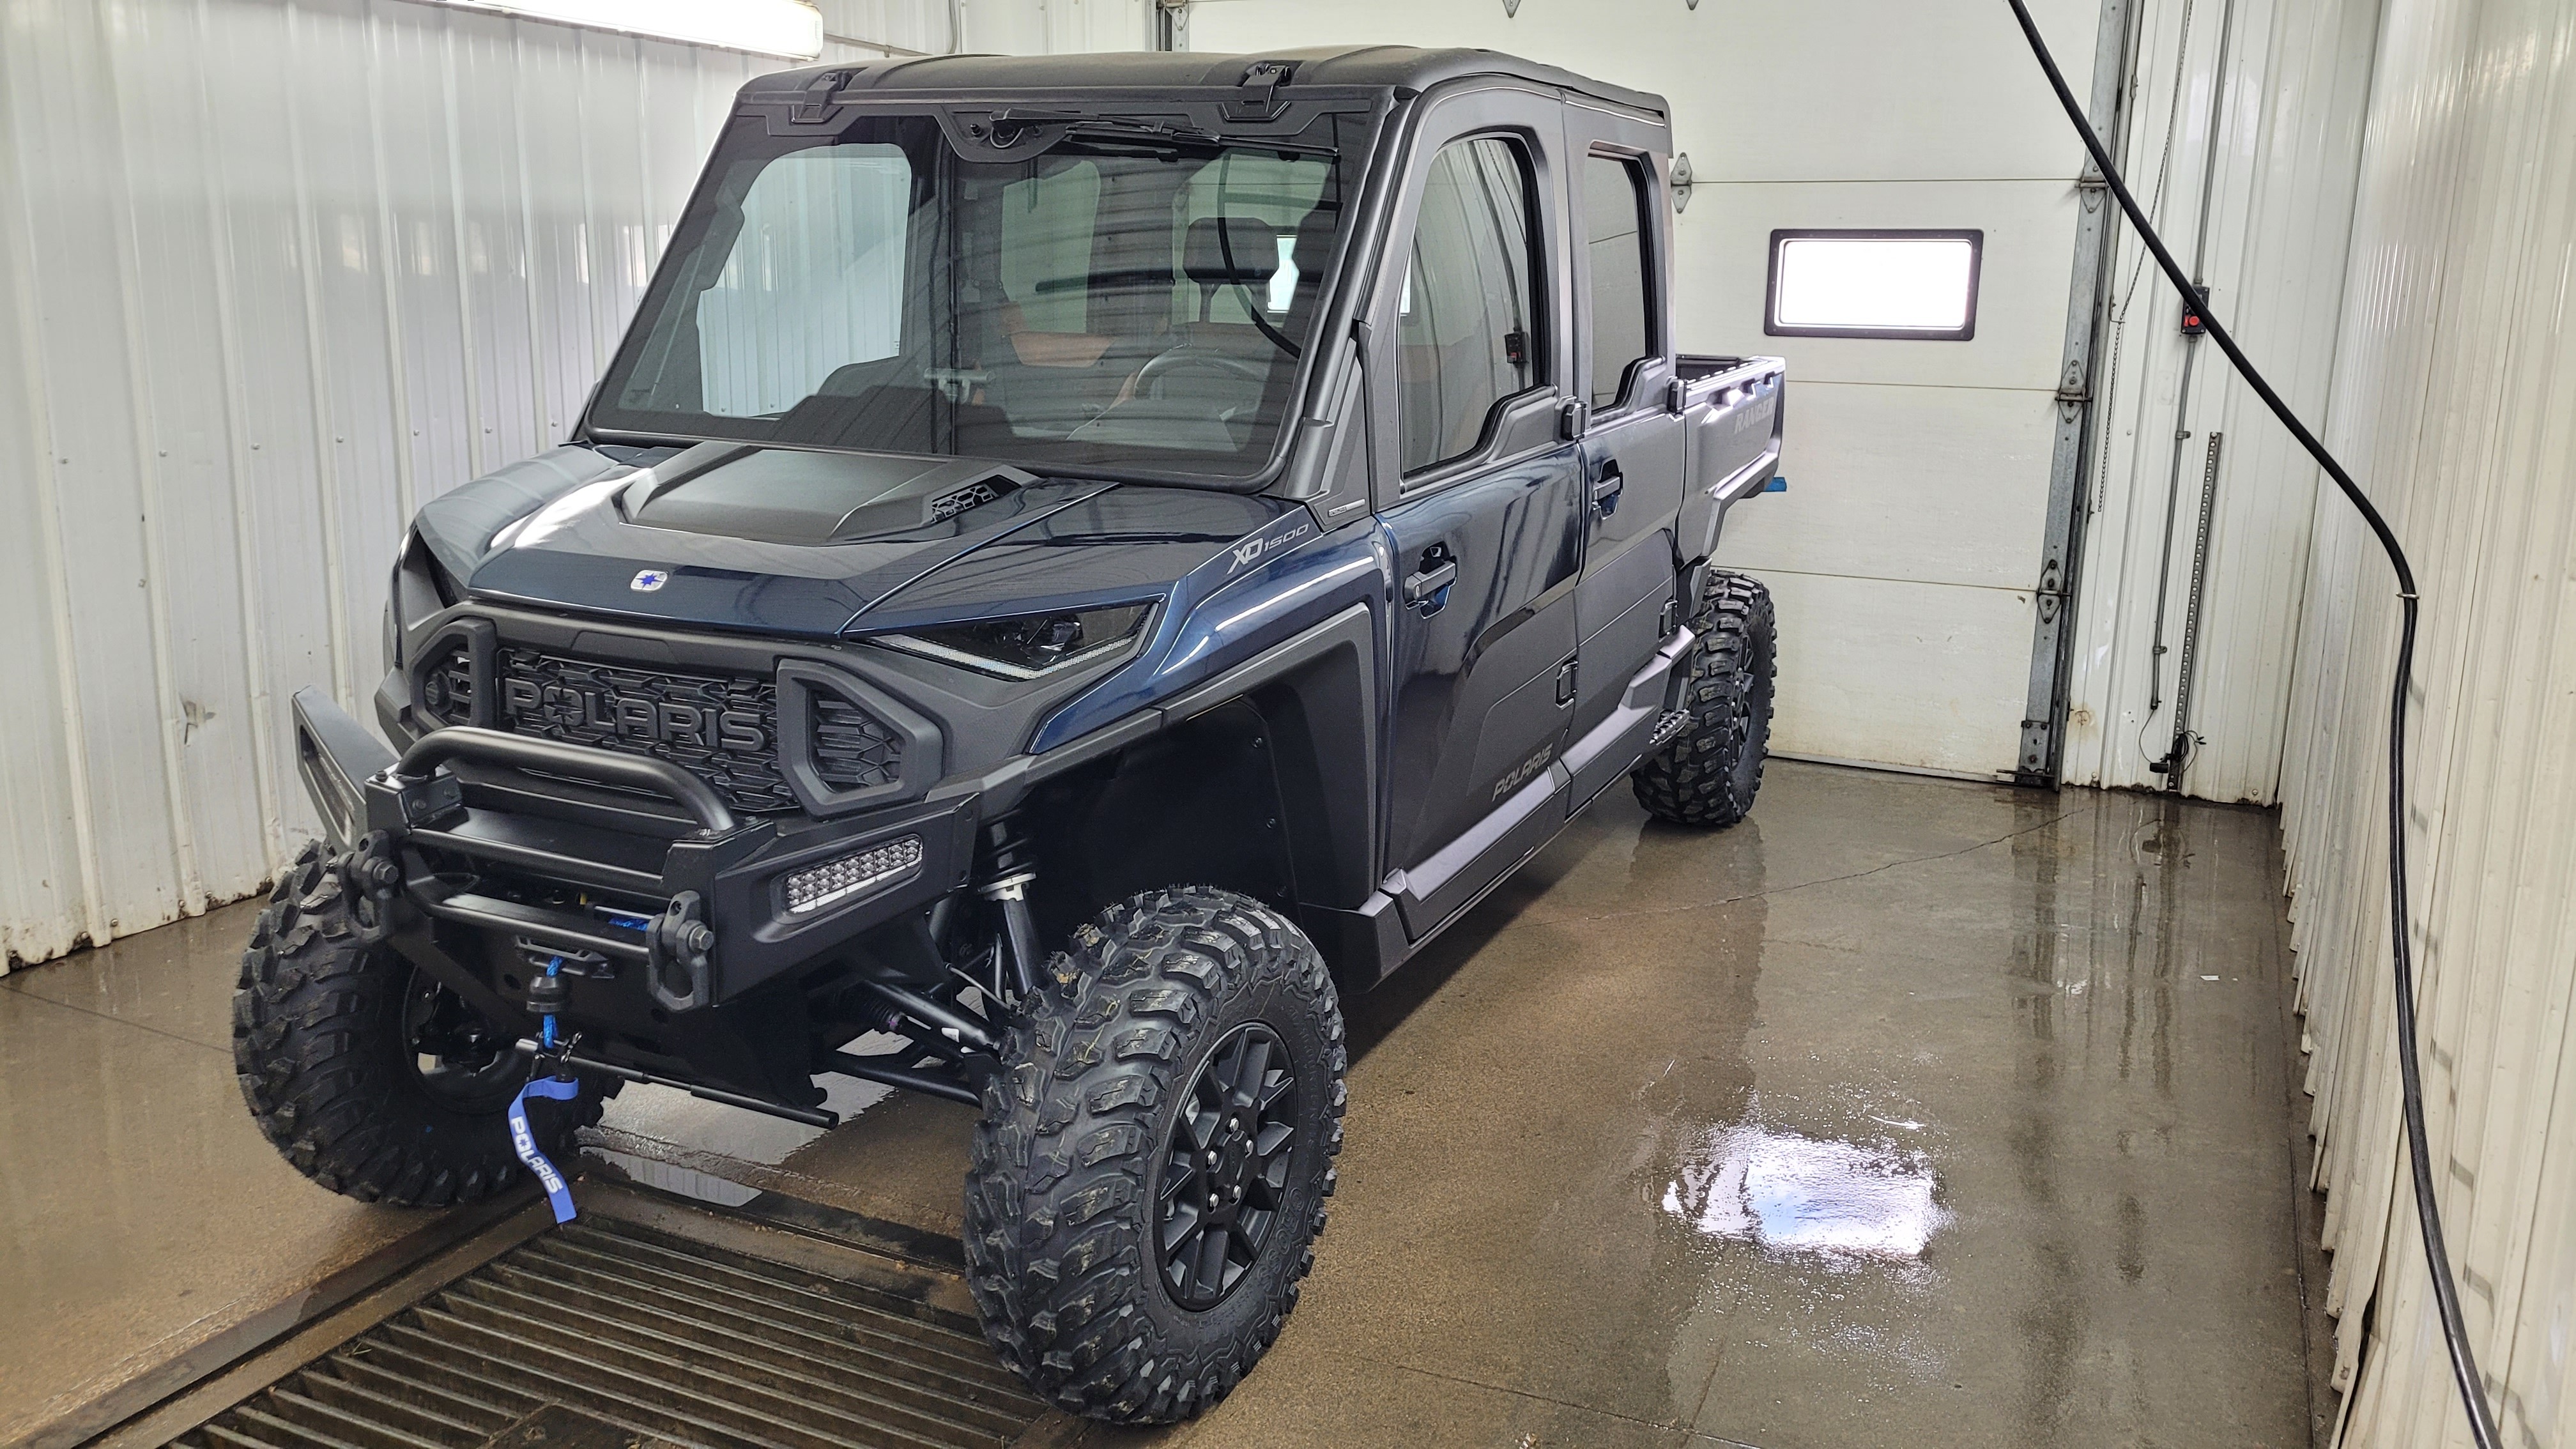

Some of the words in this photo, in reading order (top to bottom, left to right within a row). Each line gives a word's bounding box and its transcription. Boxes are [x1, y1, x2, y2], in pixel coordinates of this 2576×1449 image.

[1735, 397, 1775, 434] RANGER
[505, 677, 765, 751] POLARIS
[1492, 742, 1554, 802] POLARIS
[510, 1117, 564, 1194] POLARIS
